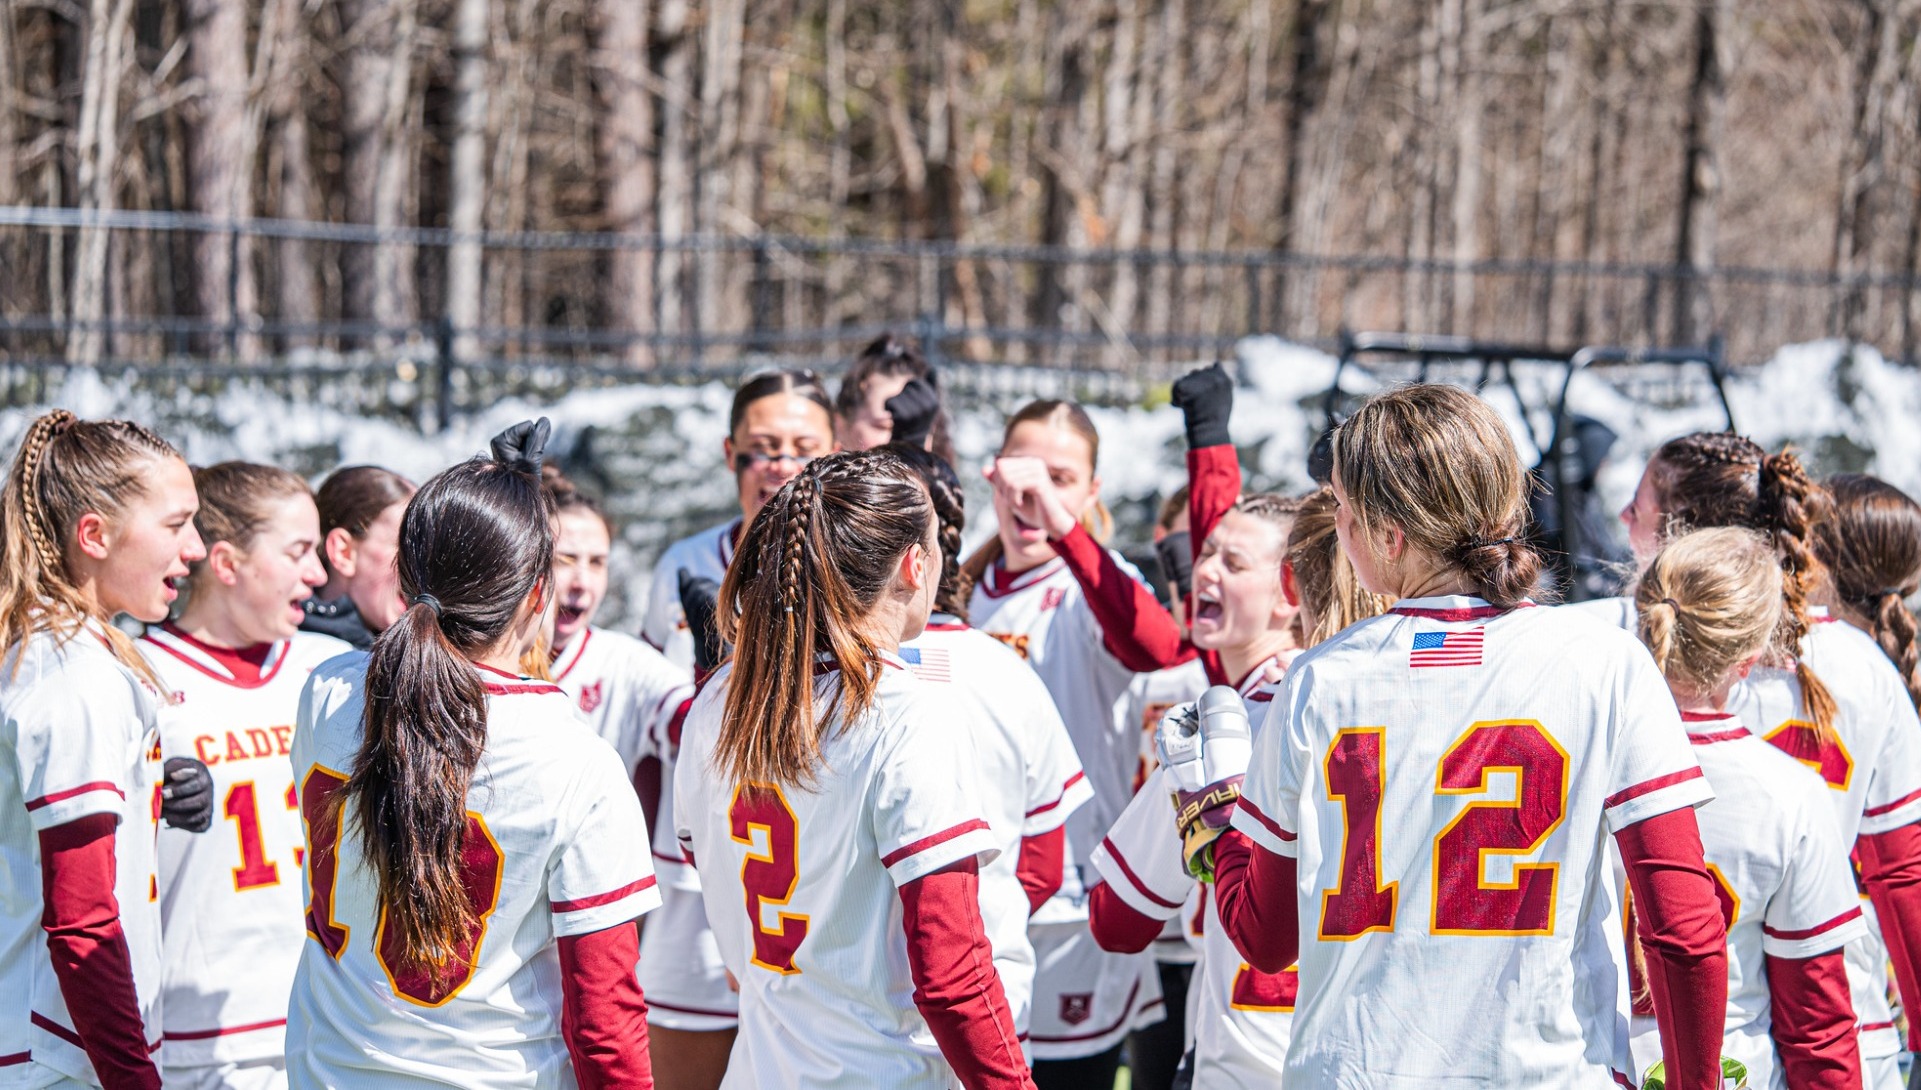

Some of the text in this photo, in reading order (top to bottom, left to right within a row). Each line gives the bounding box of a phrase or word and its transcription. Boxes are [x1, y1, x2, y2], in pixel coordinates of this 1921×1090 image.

[194, 725, 296, 766] CADE
[1318, 718, 1571, 942] 12
[730, 780, 810, 976] 2
